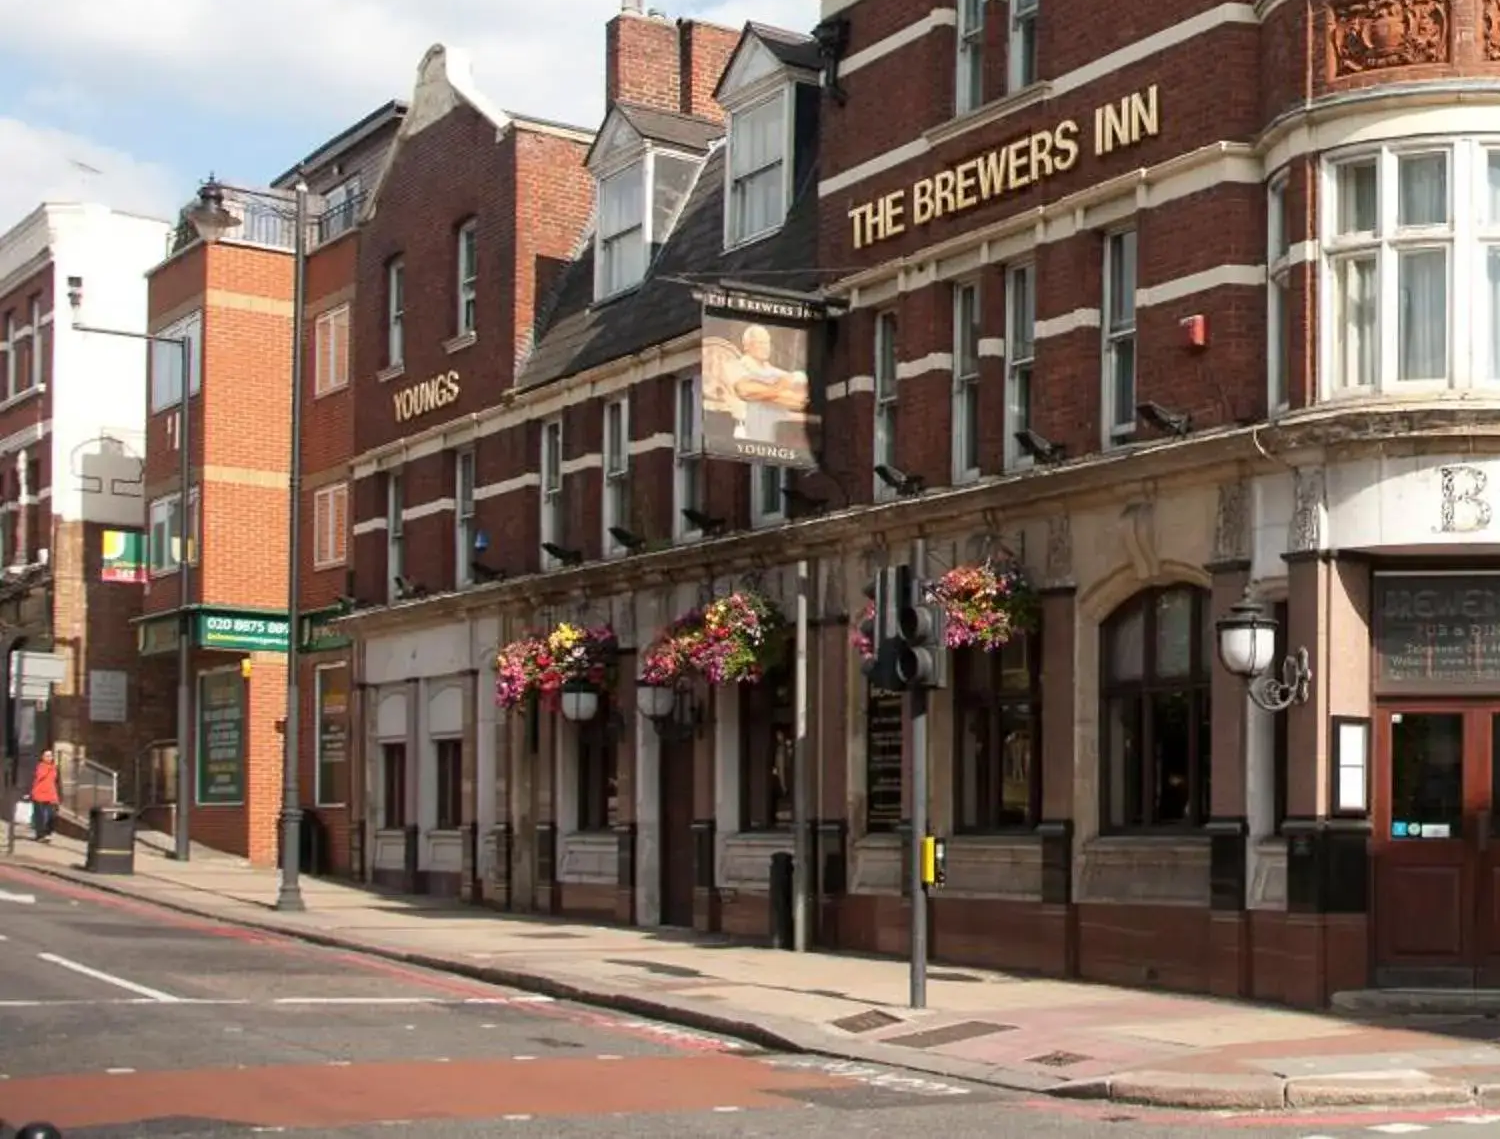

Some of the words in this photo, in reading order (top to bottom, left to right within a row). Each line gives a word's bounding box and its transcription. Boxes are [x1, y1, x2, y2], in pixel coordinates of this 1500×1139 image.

[848, 190, 905, 250] THE
[912, 119, 1080, 225] BREWERS
[1094, 84, 1159, 156] INN
[738, 297, 794, 317] BREWERS
[393, 370, 460, 423] YOUNGS
[737, 444, 796, 460] YOUNGS
[1432, 466, 1493, 533] B
[206, 617, 232, 630] 020
